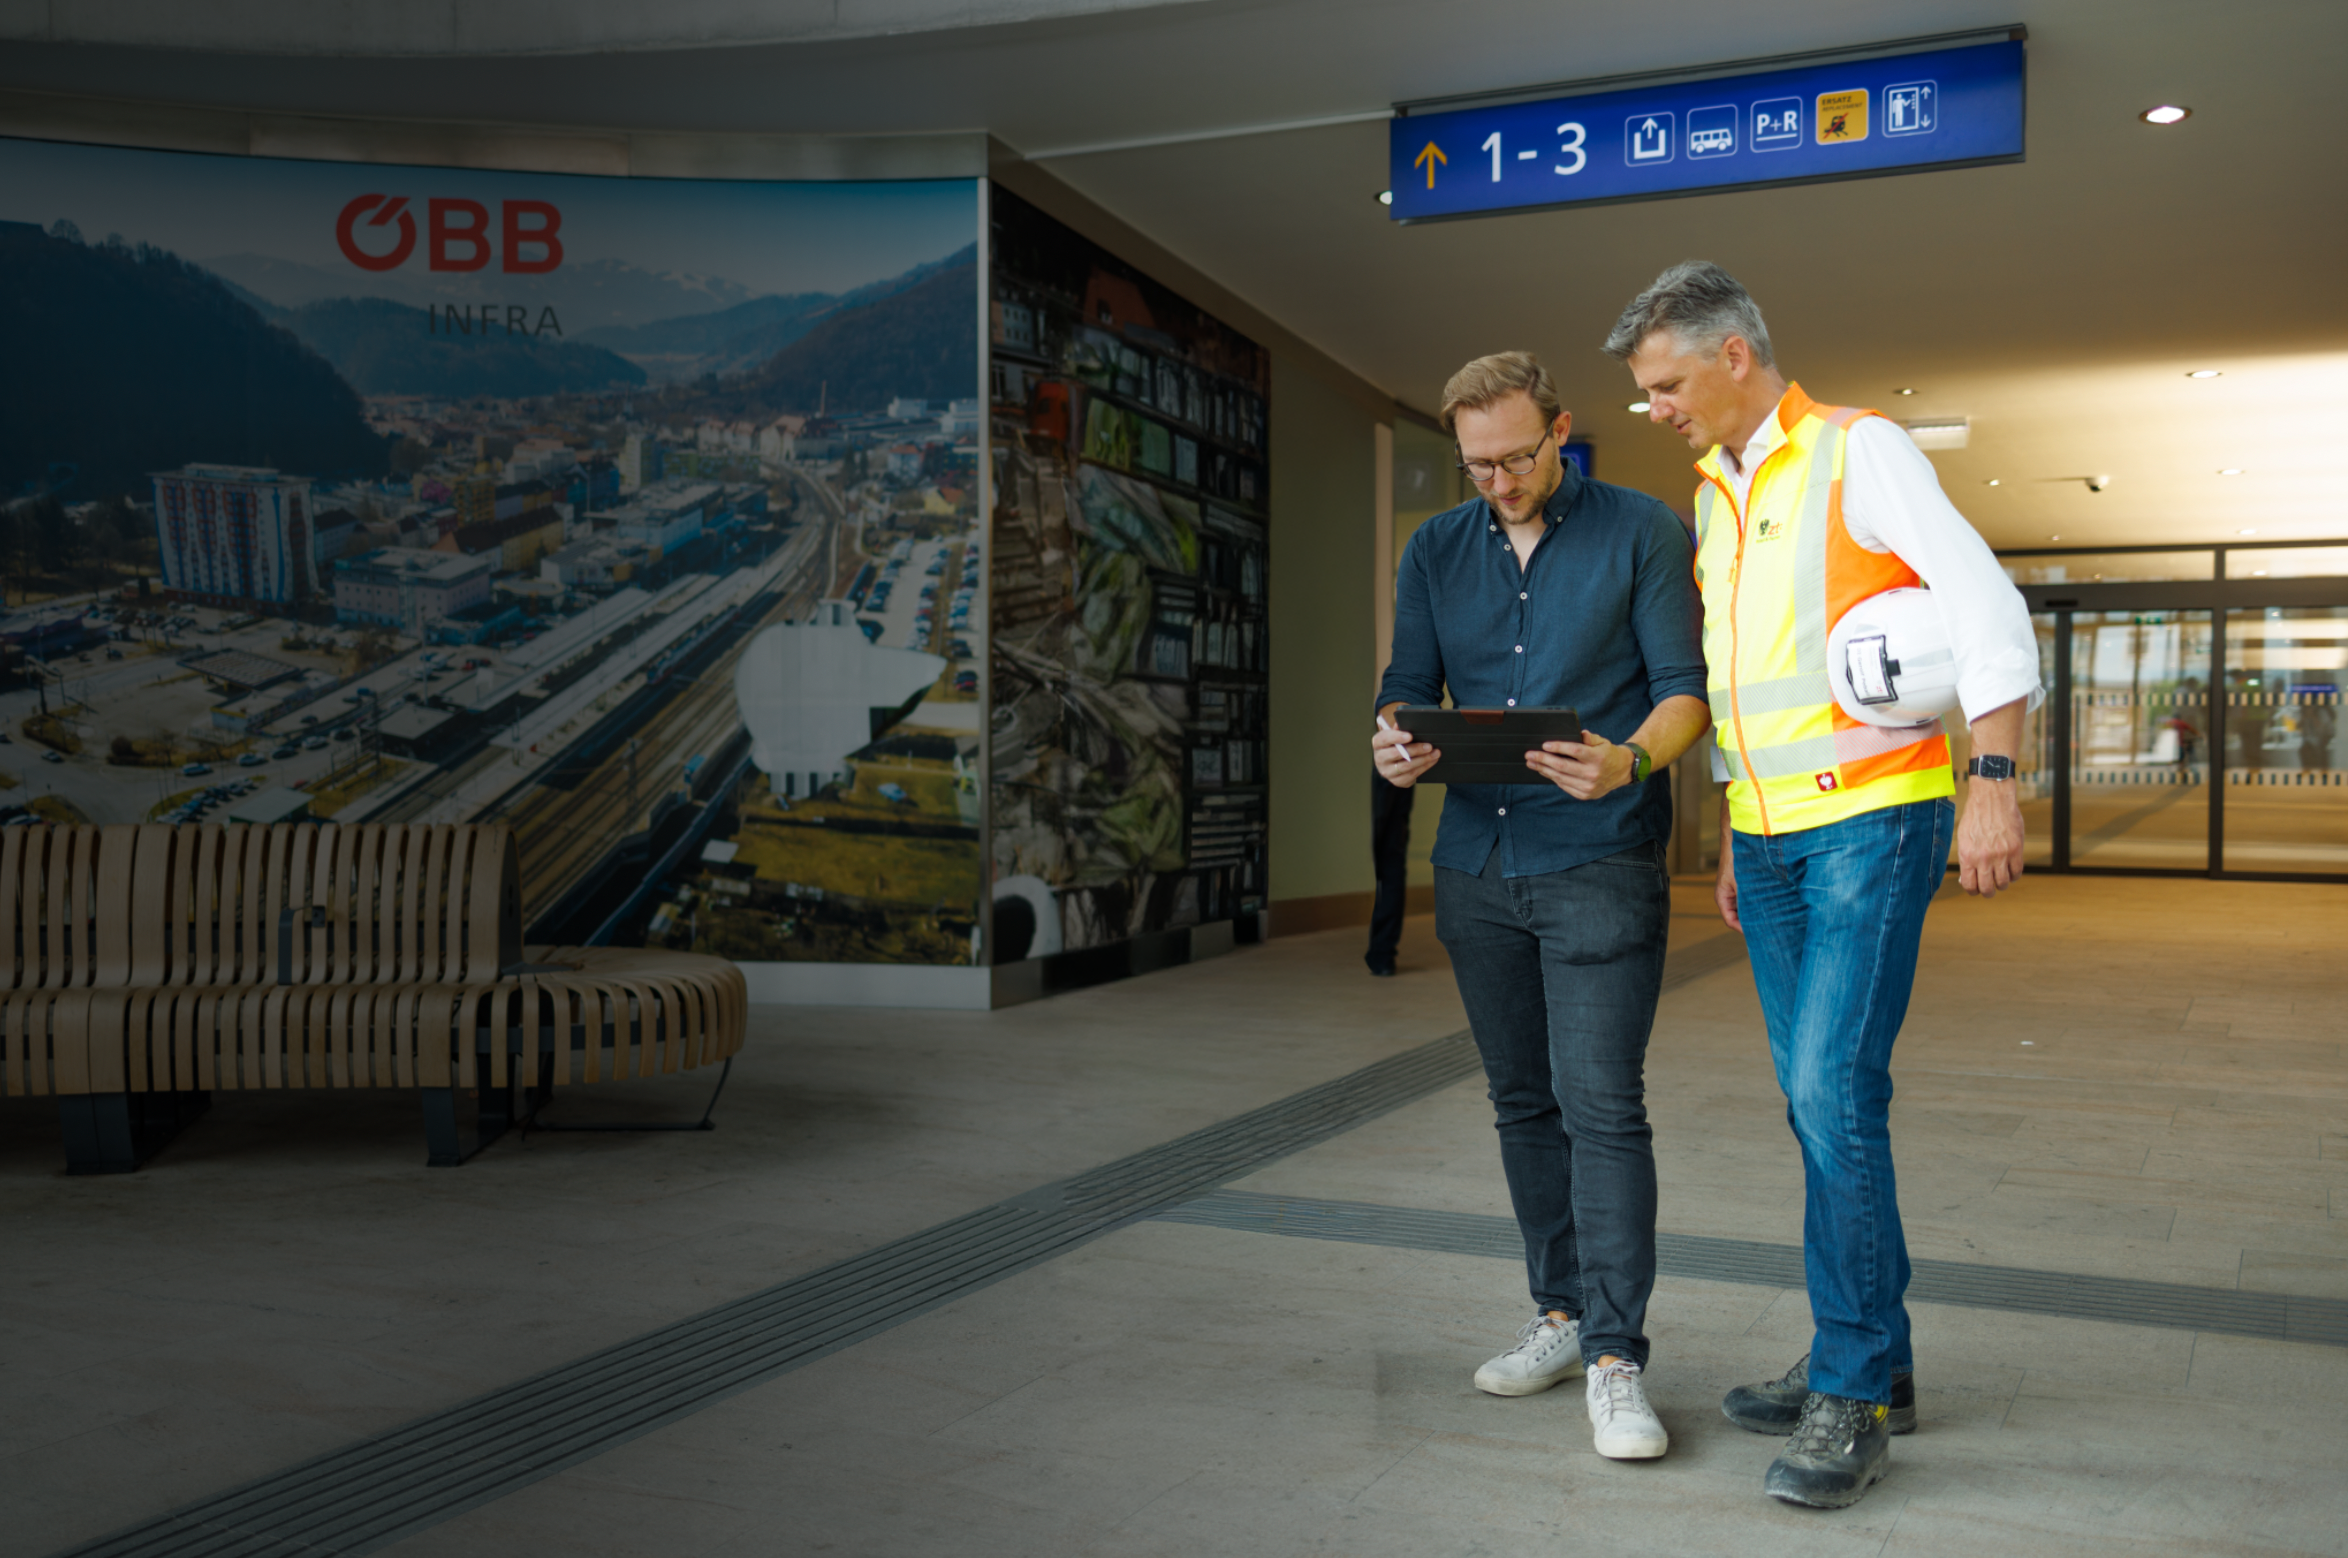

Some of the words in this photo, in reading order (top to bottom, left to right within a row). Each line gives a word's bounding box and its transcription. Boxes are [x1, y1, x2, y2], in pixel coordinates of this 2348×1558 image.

[1756, 110, 1797, 135] P+R
[335, 193, 564, 274] ÖBB
[429, 303, 563, 337] INFRA
